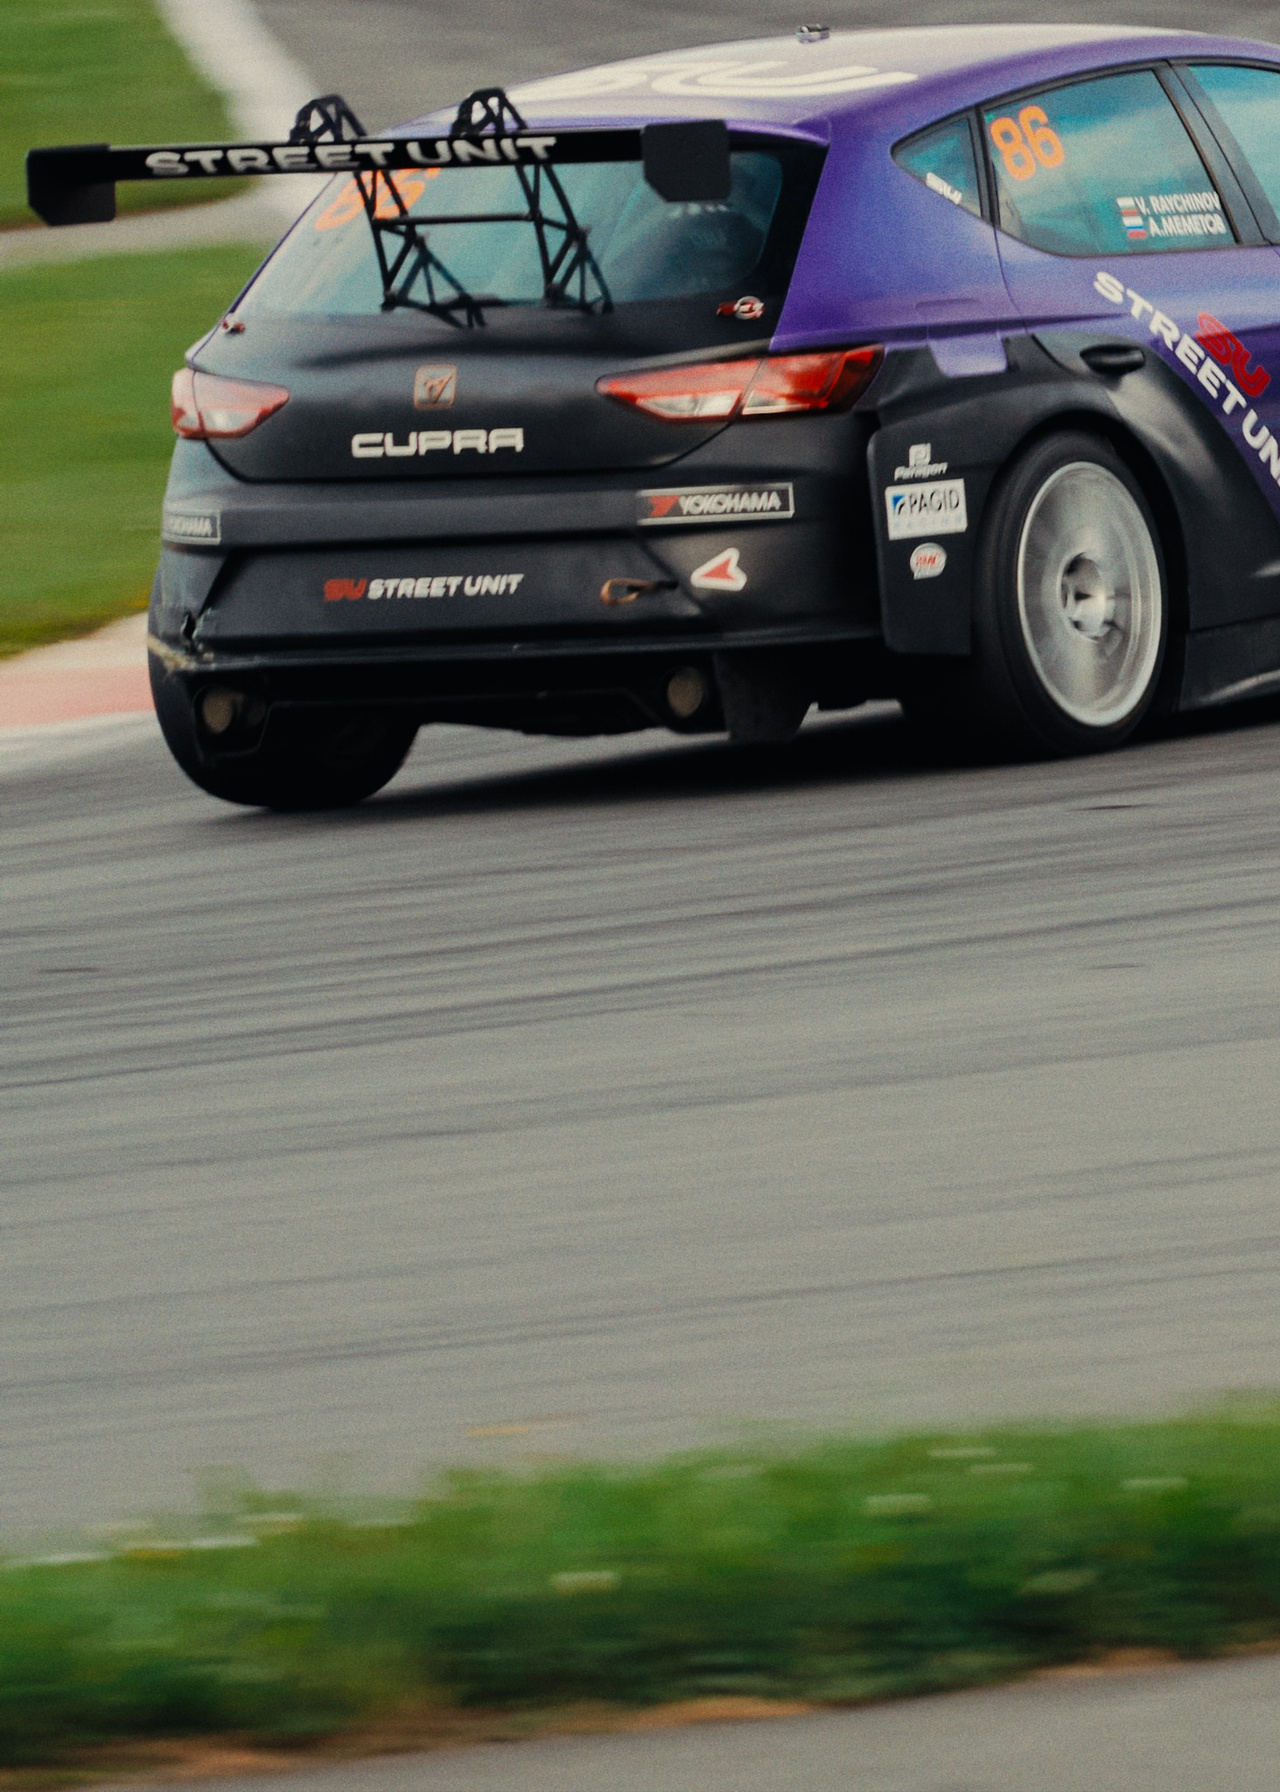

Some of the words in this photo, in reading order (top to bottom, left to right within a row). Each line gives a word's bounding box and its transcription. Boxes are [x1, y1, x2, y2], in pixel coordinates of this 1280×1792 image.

[145, 142, 396, 175] STREET
[406, 136, 558, 165] UNIT
[990, 105, 1064, 181] 86
[1093, 271, 1248, 416] STREET
[351, 427, 524, 458] CUPRA
[678, 491, 782, 516] YOKOHAMA
[909, 489, 960, 515] PAGID
[367, 576, 464, 600] STREET
[463, 573, 525, 597] UNIT
